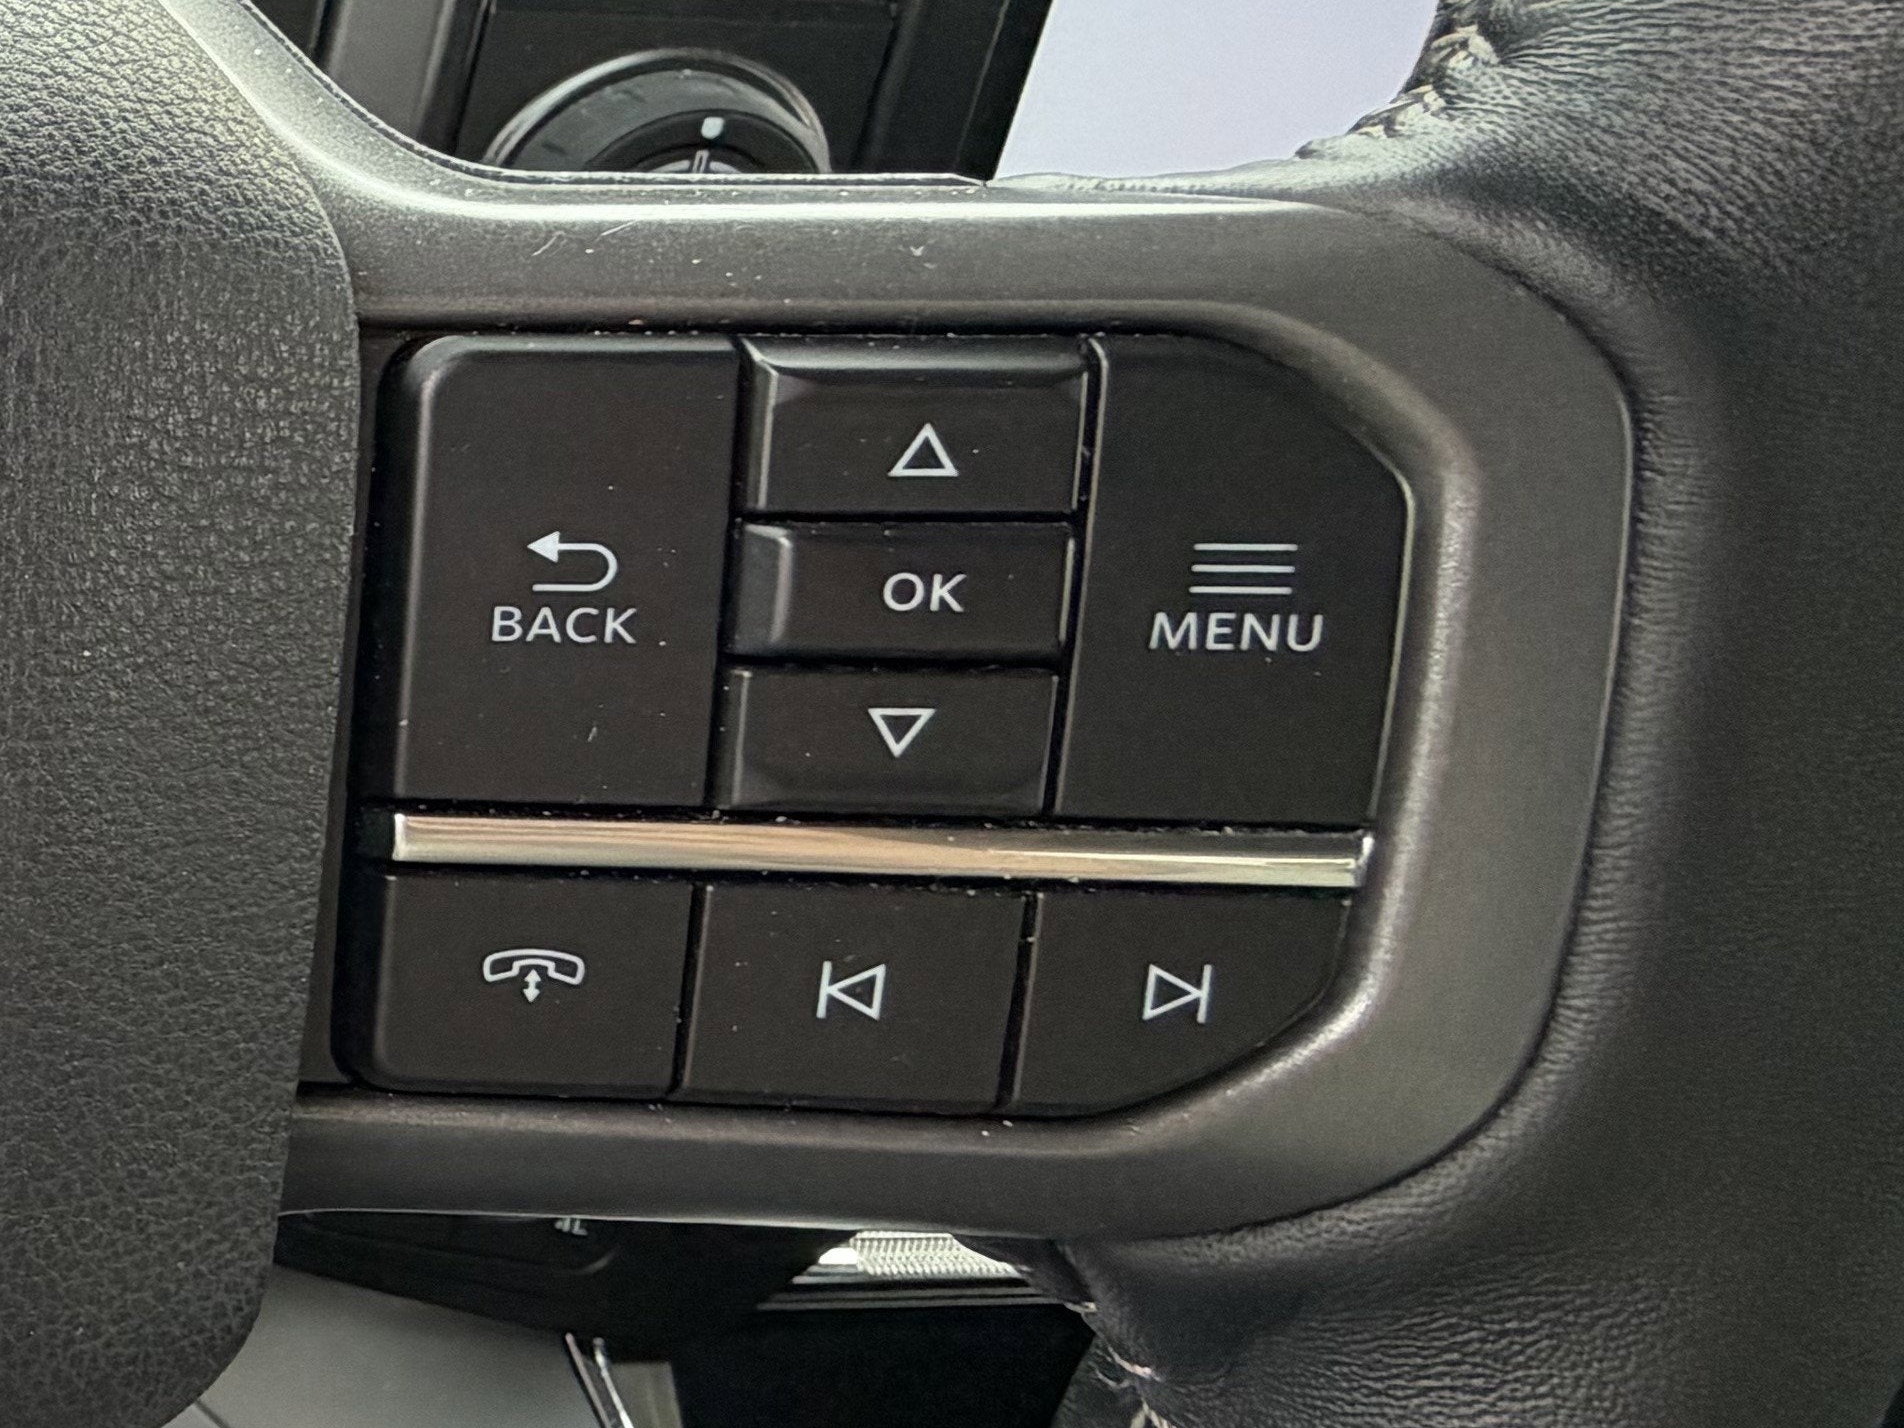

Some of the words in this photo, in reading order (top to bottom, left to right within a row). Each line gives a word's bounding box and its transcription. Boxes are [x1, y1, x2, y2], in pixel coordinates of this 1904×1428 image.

[882, 572, 965, 613] OK
[490, 605, 638, 645] BACK
[1148, 611, 1325, 653] MENU
